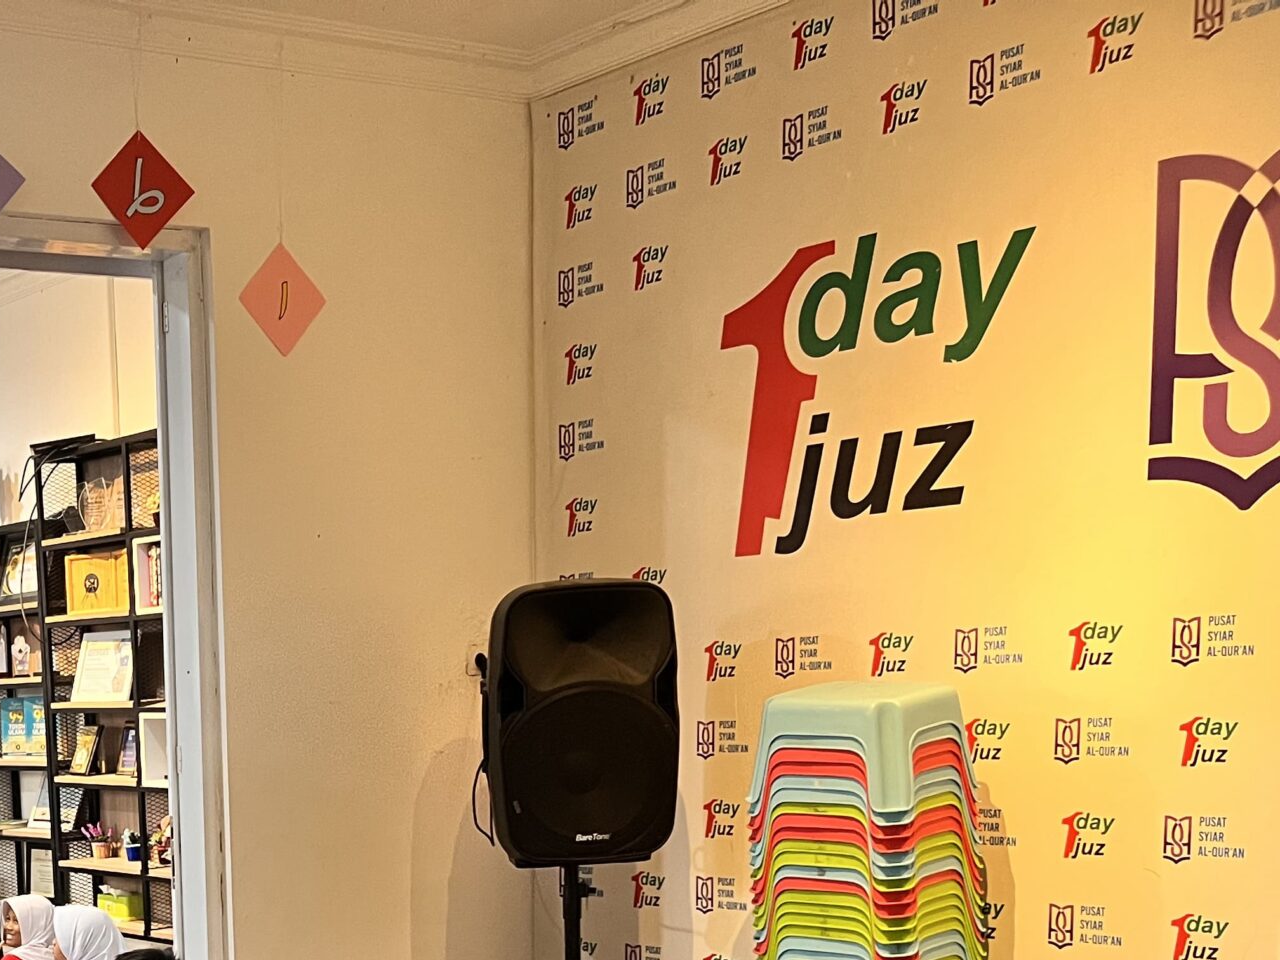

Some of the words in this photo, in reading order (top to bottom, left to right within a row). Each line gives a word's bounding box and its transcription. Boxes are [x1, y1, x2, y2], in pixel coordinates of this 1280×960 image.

[803, 17, 833, 38] day
[1102, 11, 1145, 37] day
[724, 44, 744, 59] PUSAT
[801, 43, 828, 68] juz
[1000, 43, 1025, 61] PUSAT
[1098, 42, 1135, 72] juz
[724, 58, 743, 72] SYIAR
[1000, 59, 1023, 76] SYIAR
[643, 76, 669, 96] day
[892, 79, 927, 101] day
[641, 100, 664, 124] juz
[807, 105, 828, 121] PUSAT
[889, 107, 919, 133] juz
[807, 120, 827, 135] SYIAR
[719, 135, 747, 156] day
[716, 160, 741, 184] juz
[126, 158, 165, 218] ط
[573, 184, 597, 203] day
[571, 207, 592, 227] juz
[642, 245, 669, 265] day
[640, 269, 663, 289] juz
[798, 226, 1036, 362] day
[573, 344, 597, 360] day
[571, 365, 592, 384] juz
[775, 412, 974, 554] juz
[574, 498, 598, 514] day
[572, 519, 593, 536] juz
[641, 567, 667, 584] day
[1208, 615, 1237, 626] PUSAT
[984, 626, 1008, 637] PUSAT
[1083, 622, 1123, 643] day
[1207, 630, 1234, 642] SYIAR
[714, 641, 742, 659] day
[799, 636, 819, 646] PUSAT
[881, 633, 913, 651] day
[983, 640, 1006, 651] SYIAR
[799, 648, 818, 659] SYIAR
[1078, 648, 1114, 670] juz
[711, 664, 736, 681] juz
[877, 656, 906, 676] juz
[974, 719, 1010, 738] day
[1087, 717, 1113, 728] PUSAT
[1194, 717, 1239, 740] day
[1087, 731, 1111, 742] SYIAR
[972, 745, 1002, 764] juz
[1190, 745, 1228, 767] juz
[713, 800, 740, 818] day
[979, 809, 1002, 819] PUSAT
[711, 820, 734, 839] juz
[1075, 812, 1115, 834] day
[1199, 816, 1228, 828] PUSAT
[1198, 831, 1225, 842] SYIAR
[1071, 838, 1106, 858] juz
[640, 873, 665, 890] day
[638, 892, 661, 908] juz
[1080, 906, 1106, 917] PUSAT
[1080, 920, 1103, 931] SYIAR
[1186, 916, 1229, 938] day
